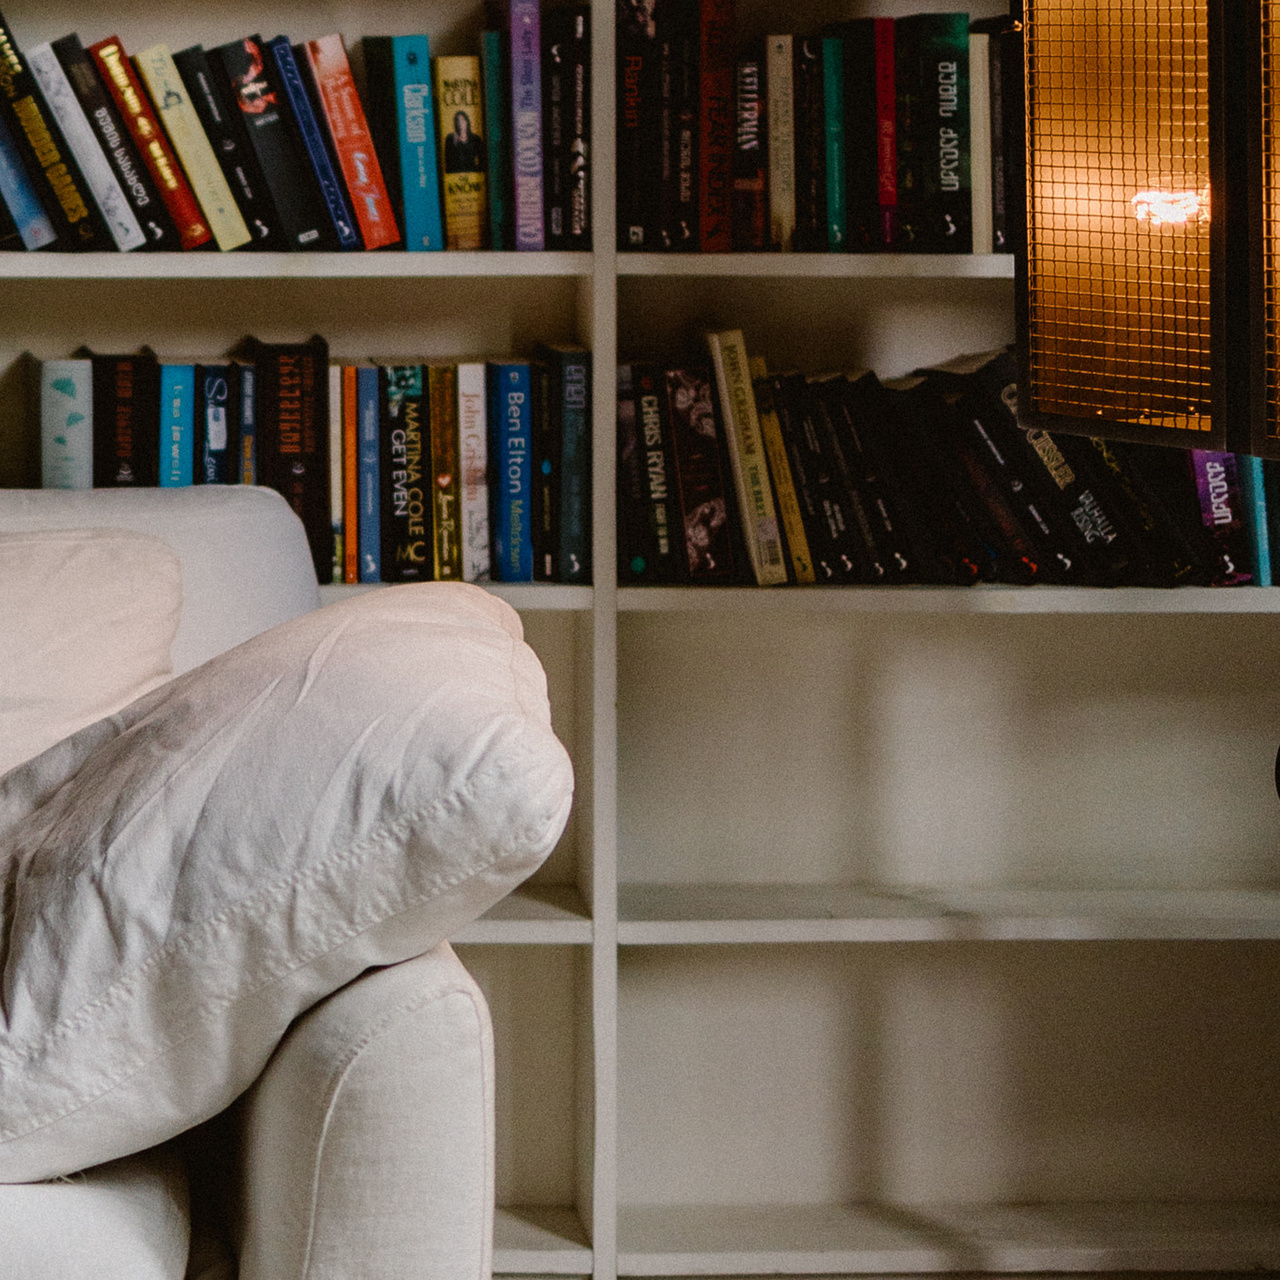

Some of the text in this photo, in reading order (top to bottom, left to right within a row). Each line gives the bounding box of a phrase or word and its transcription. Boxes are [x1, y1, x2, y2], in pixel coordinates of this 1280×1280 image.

[403, 85, 429, 142] Clarkson
[442, 88, 477, 106] COLE
[625, 57, 642, 127] Rankin
[937, 61, 960, 191] შუშის ქალაქი
[12, 95, 88, 223] MURDER GAMES
[727, 344, 745, 384] JOHN
[508, 392, 524, 431] Ben
[641, 395, 662, 446] CHRIS
[733, 386, 756, 455] GRISHAM
[392, 430, 408, 515] GET EVEN
[405, 402, 424, 535] MARTINA COLE
[462, 392, 481, 501] John Grisham
[507, 437, 525, 493] Elton
[647, 451, 667, 499] RYAN
[1027, 428, 1075, 490] CUSSLER
[1071, 507, 1102, 544] RISING
[1078, 489, 1117, 544] VALHALLA
